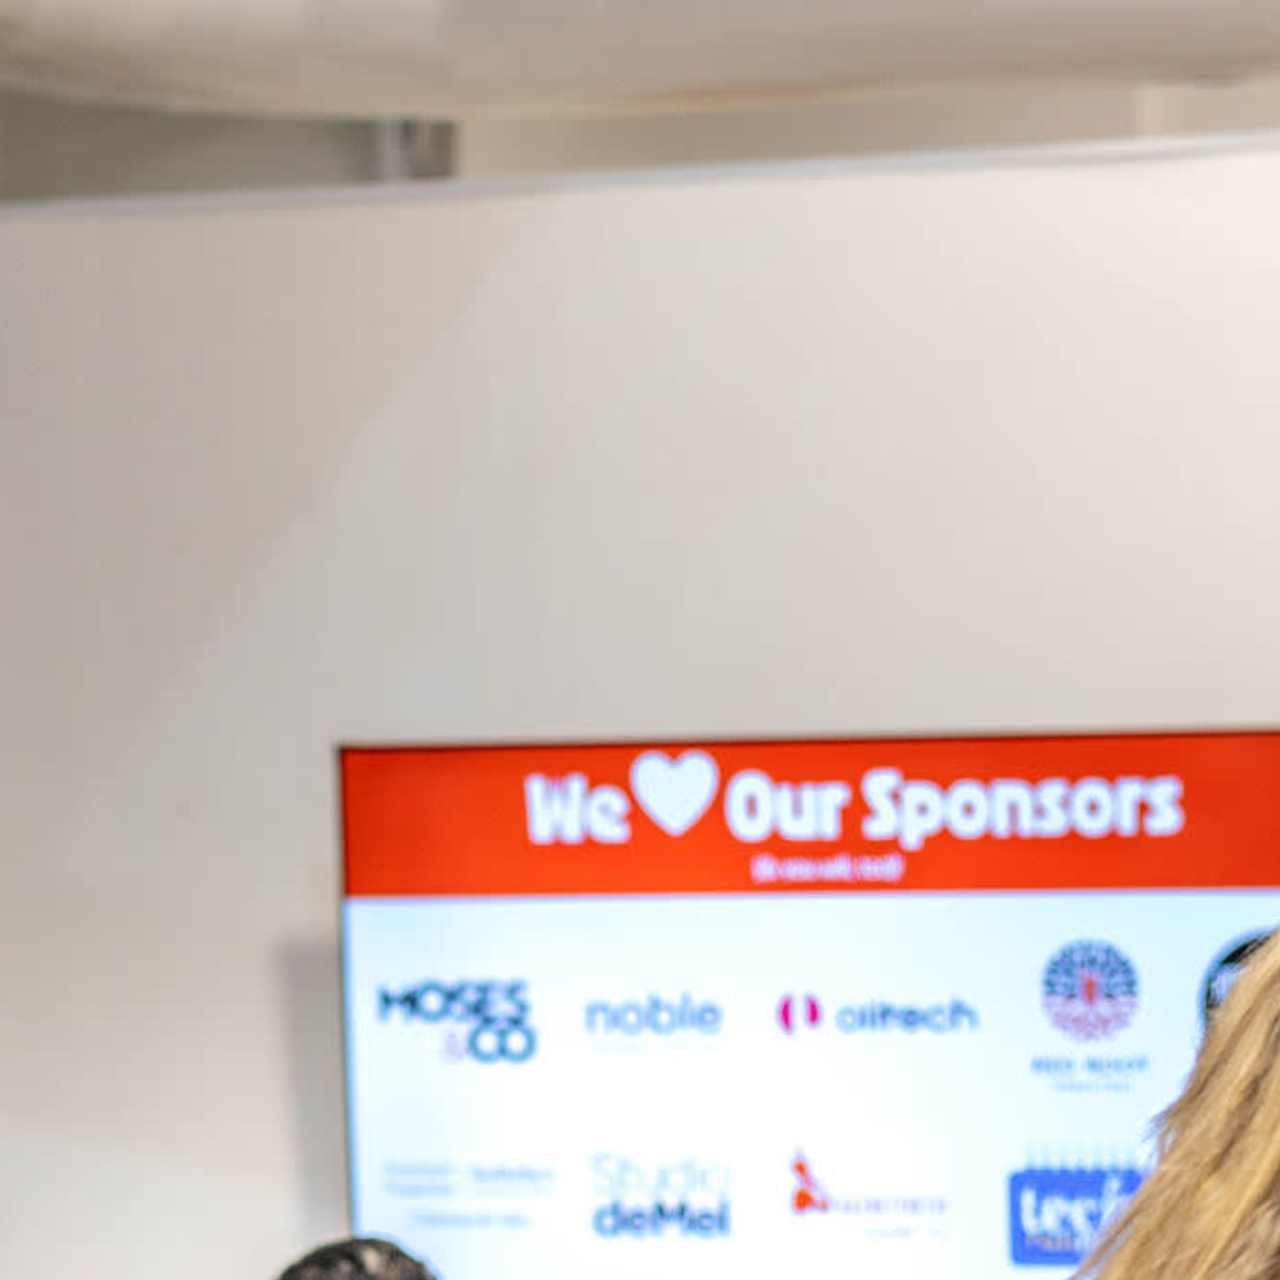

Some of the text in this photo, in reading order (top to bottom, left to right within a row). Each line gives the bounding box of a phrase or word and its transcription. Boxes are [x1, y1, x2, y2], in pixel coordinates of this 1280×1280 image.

[525, 768, 1184, 851] We Our Sponsors
[376, 979, 529, 1024] MOSES
[584, 992, 723, 1034] noble
